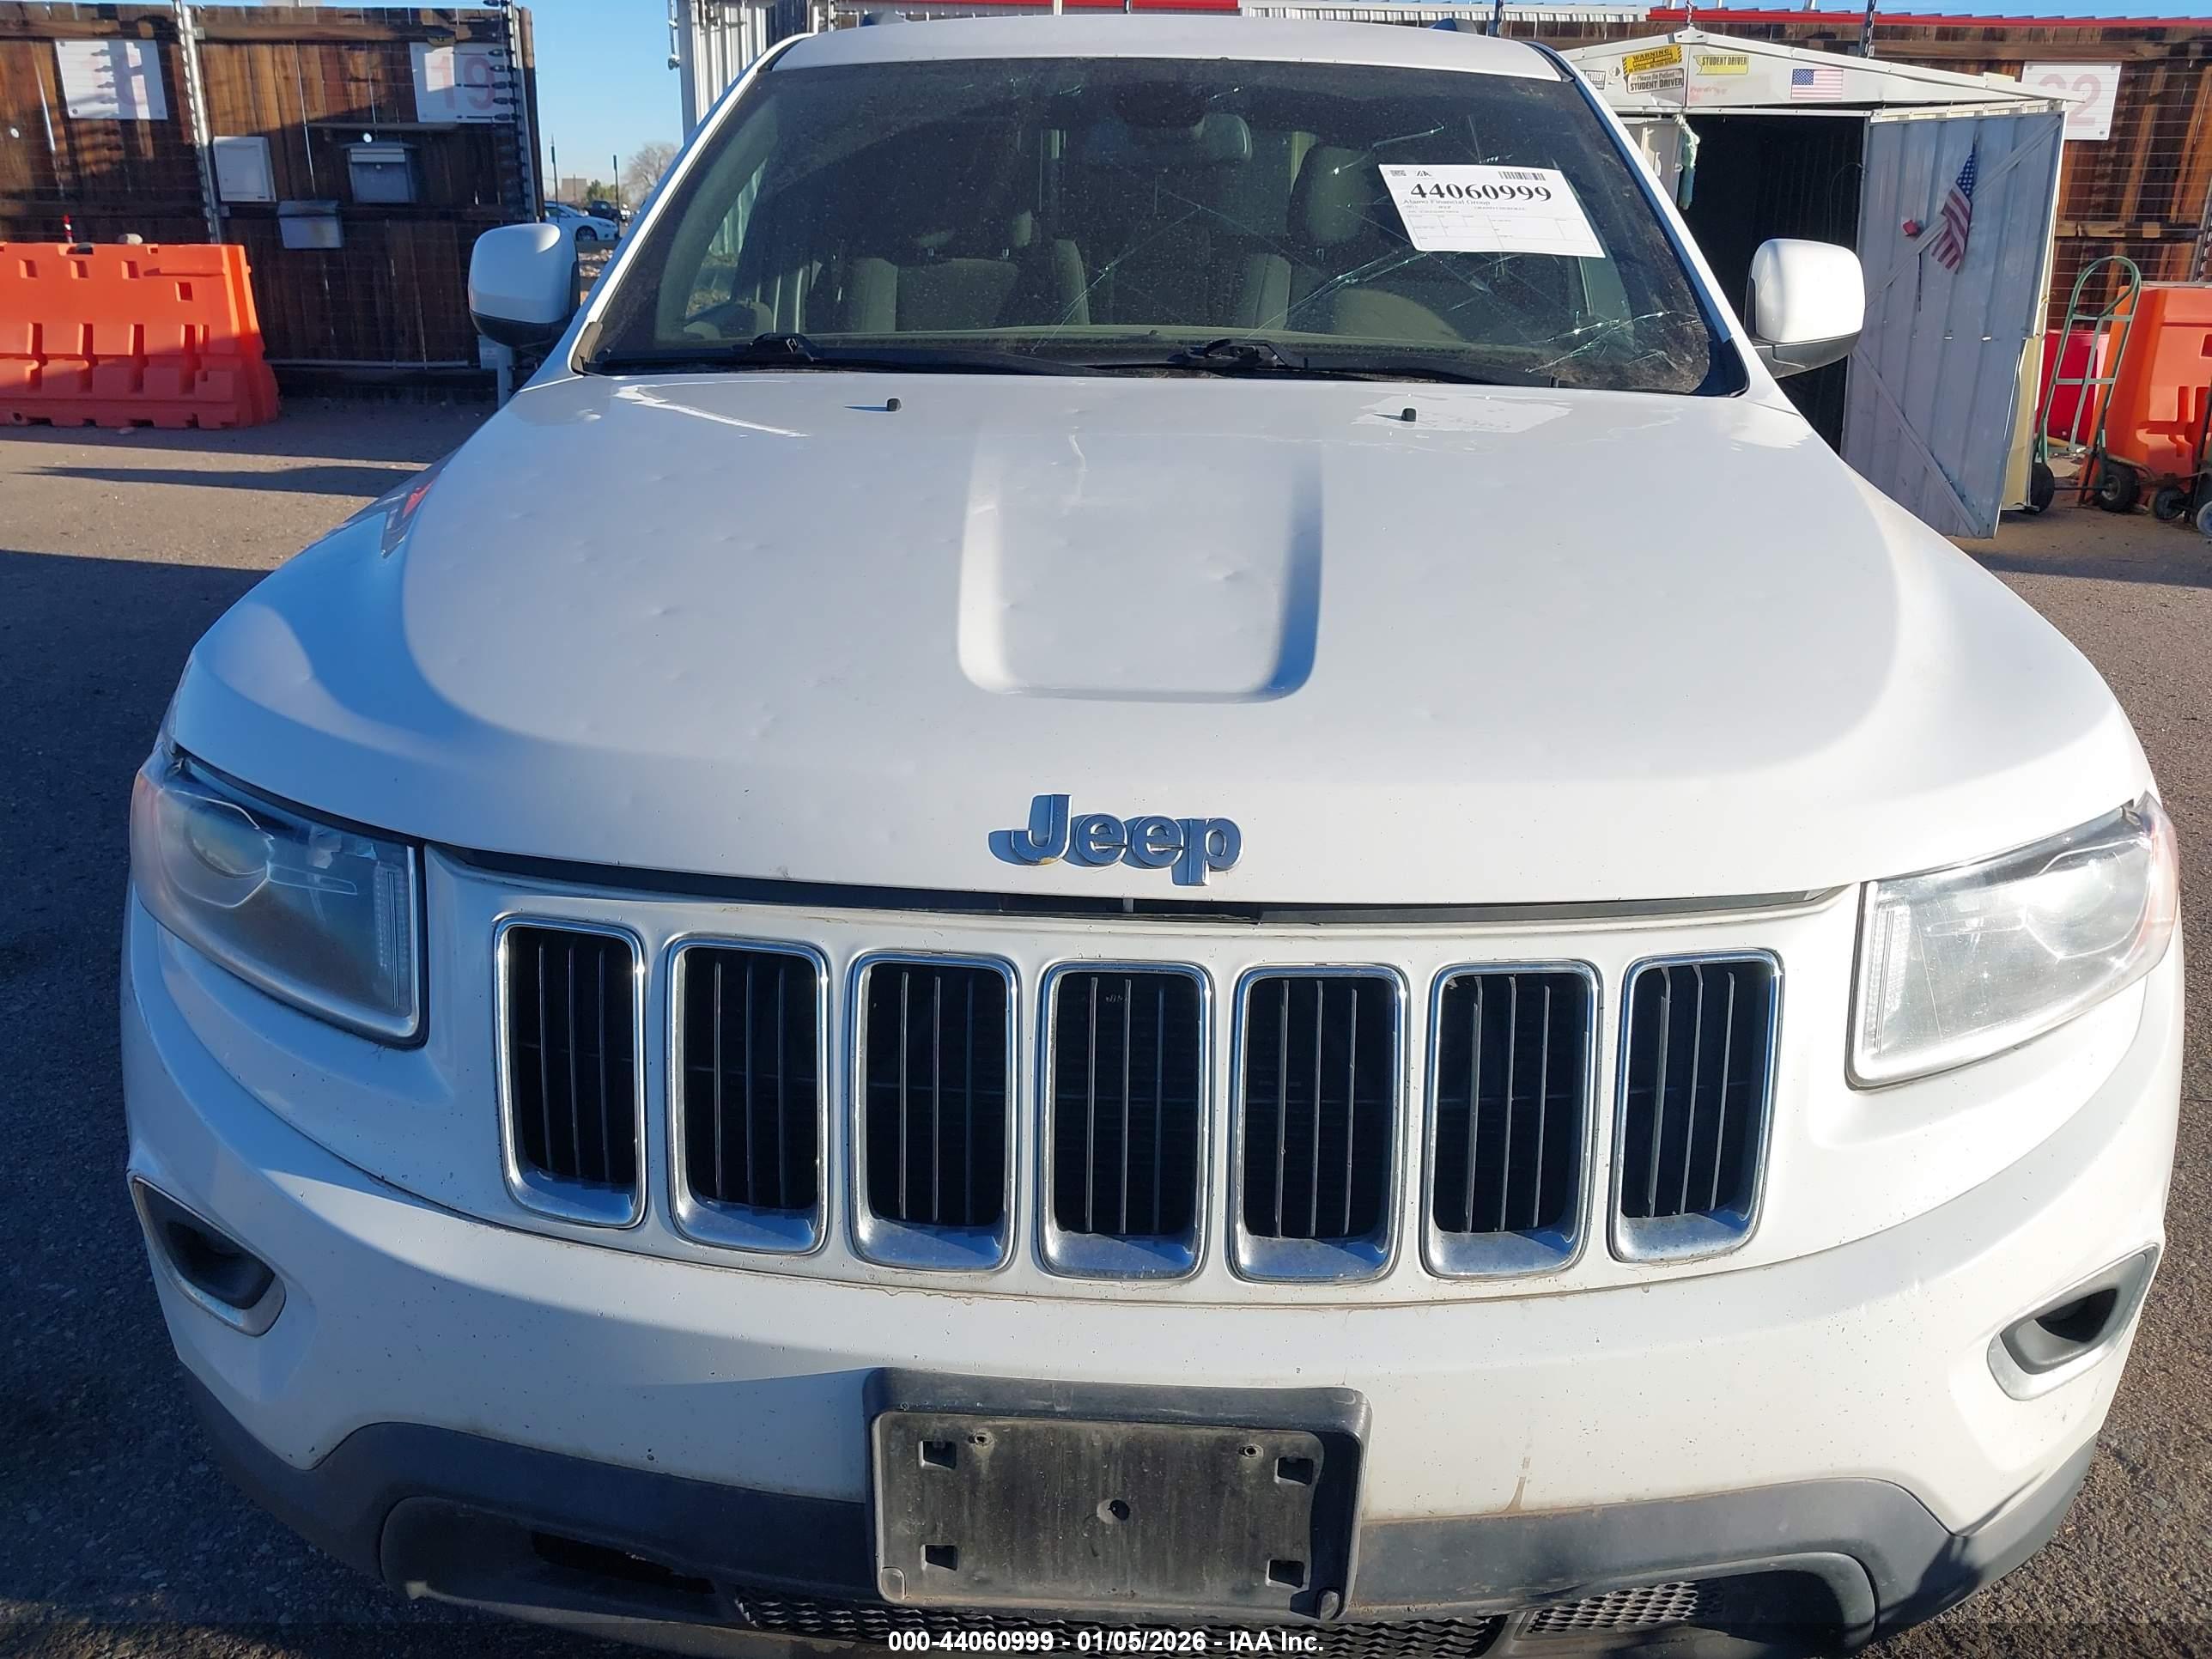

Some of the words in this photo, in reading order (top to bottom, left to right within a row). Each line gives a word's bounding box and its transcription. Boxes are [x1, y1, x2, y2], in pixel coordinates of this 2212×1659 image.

[1633, 48, 1670, 61] WARNING
[1702, 56, 1727, 66] STUDENT
[1728, 56, 1747, 66] DRIVER
[429, 55, 496, 111] 19
[1630, 80, 1657, 91] STUDENT
[1659, 77, 1684, 88] DRIVER
[1410, 182, 1553, 203] 44060999
[988, 793, 1244, 886] Jeep
